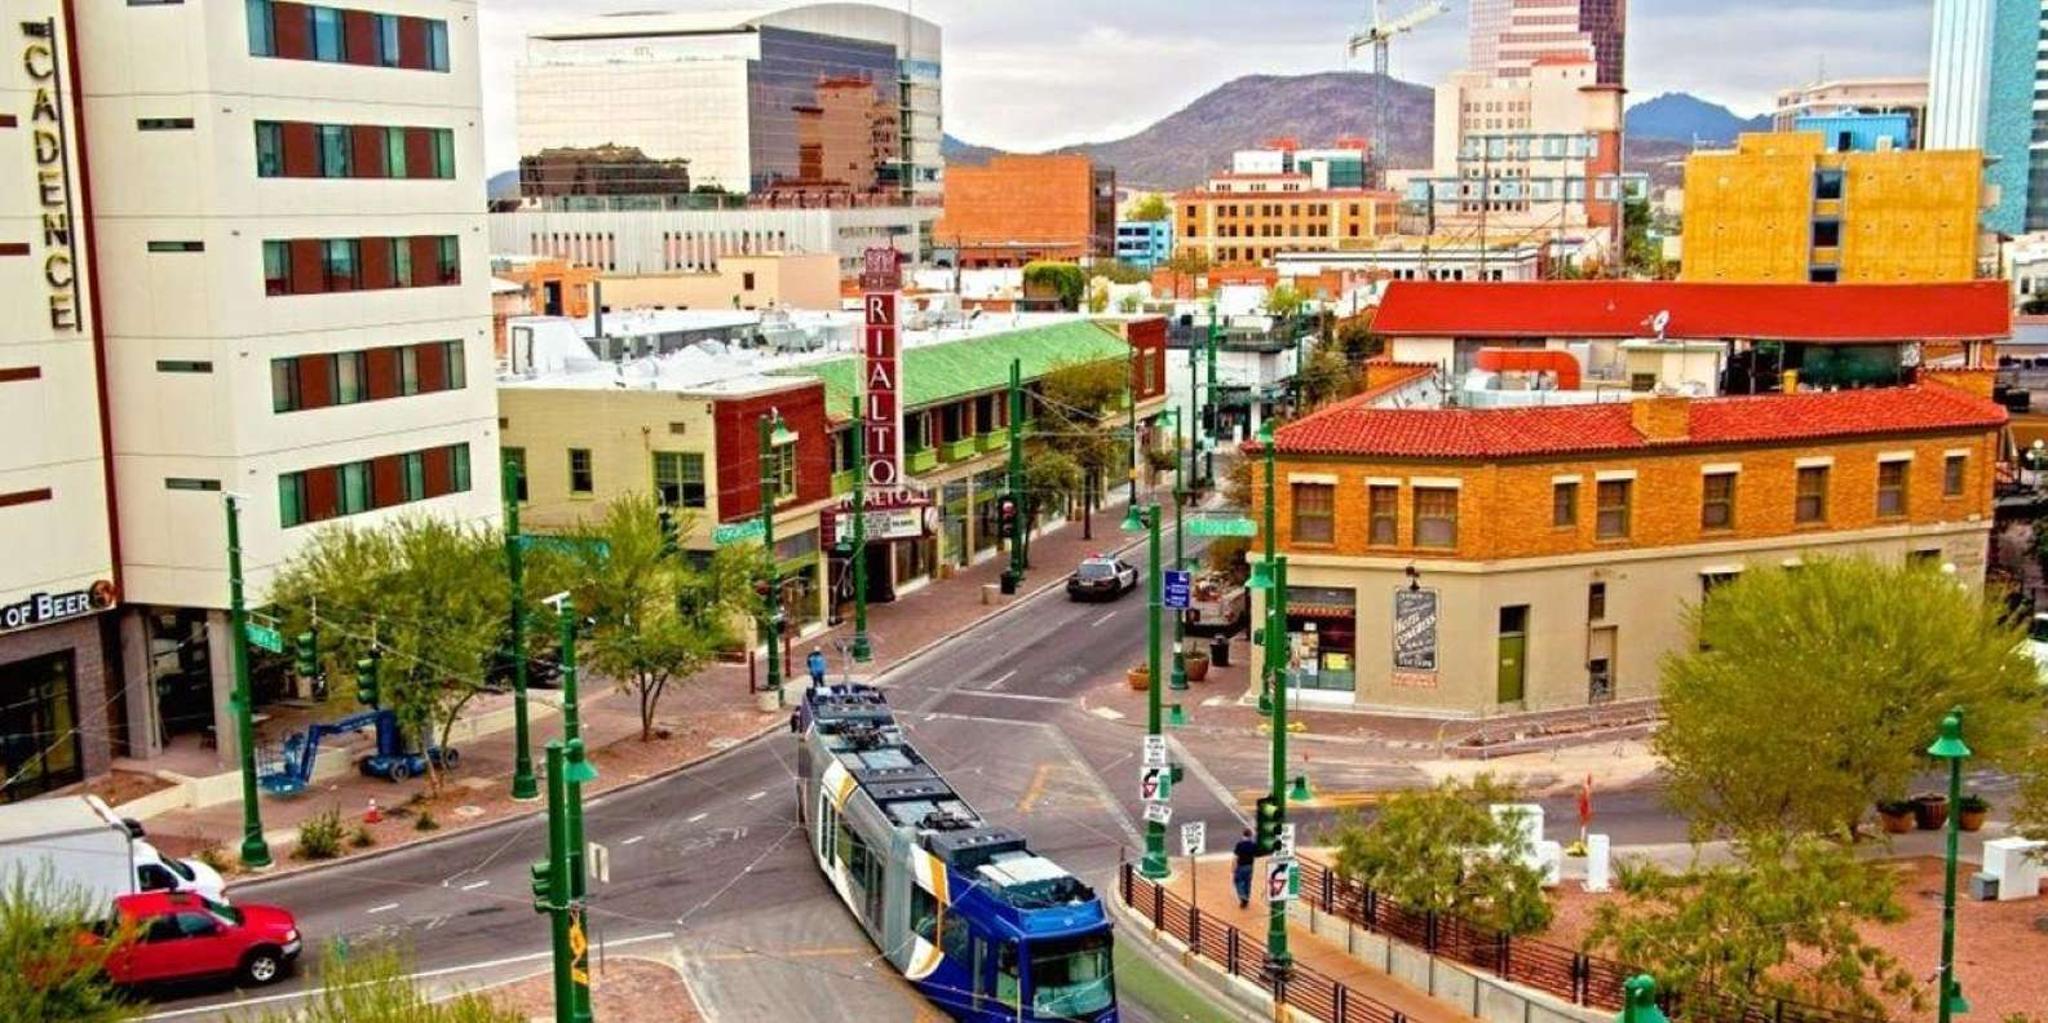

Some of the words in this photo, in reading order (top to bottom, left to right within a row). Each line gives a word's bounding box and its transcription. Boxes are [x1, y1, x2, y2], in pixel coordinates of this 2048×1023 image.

[24, 45, 74, 330] CADENCE
[868, 296, 896, 485] RIALTO
[840, 489, 911, 508] RALTO
[7, 606, 32, 627] OF
[38, 594, 90, 620] BEER
